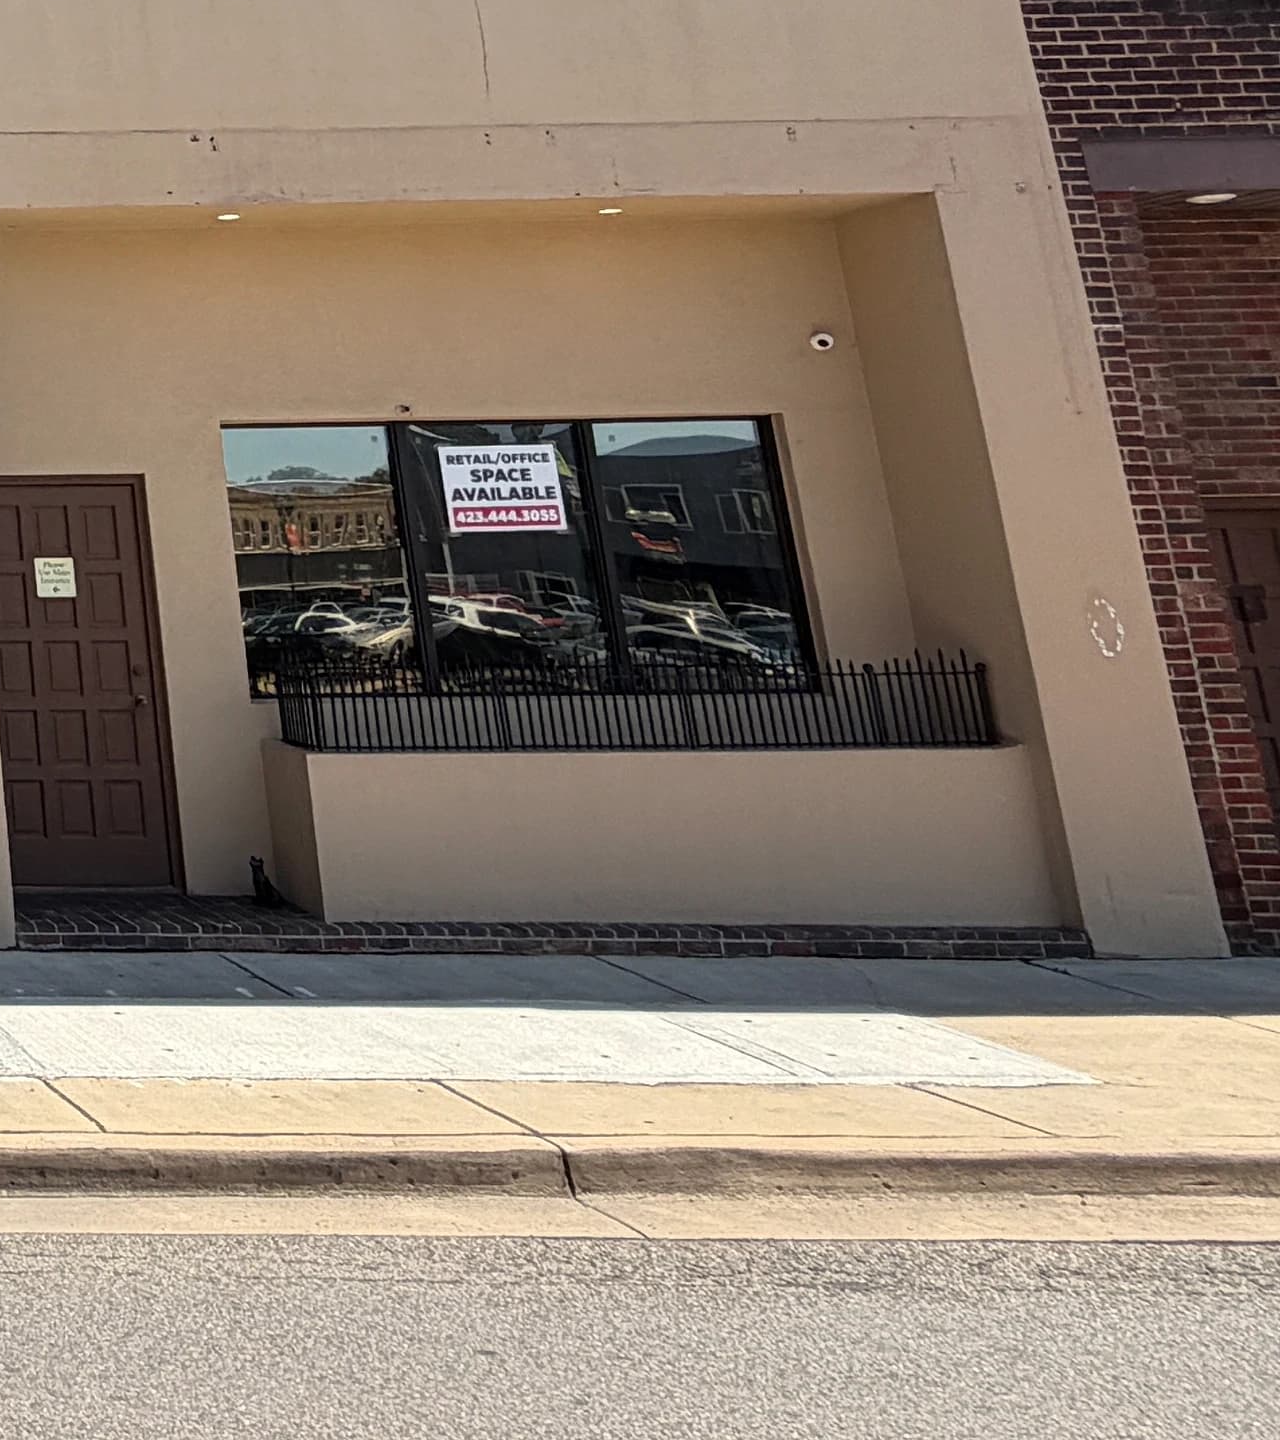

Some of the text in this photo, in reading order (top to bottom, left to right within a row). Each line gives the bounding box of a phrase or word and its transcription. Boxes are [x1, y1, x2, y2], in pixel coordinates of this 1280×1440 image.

[446, 452, 550, 465] RETAIL/OFFICE
[470, 468, 532, 482] SPACE
[451, 486, 557, 501] AVAILABLE
[456, 509, 558, 522] 423.444.3055
